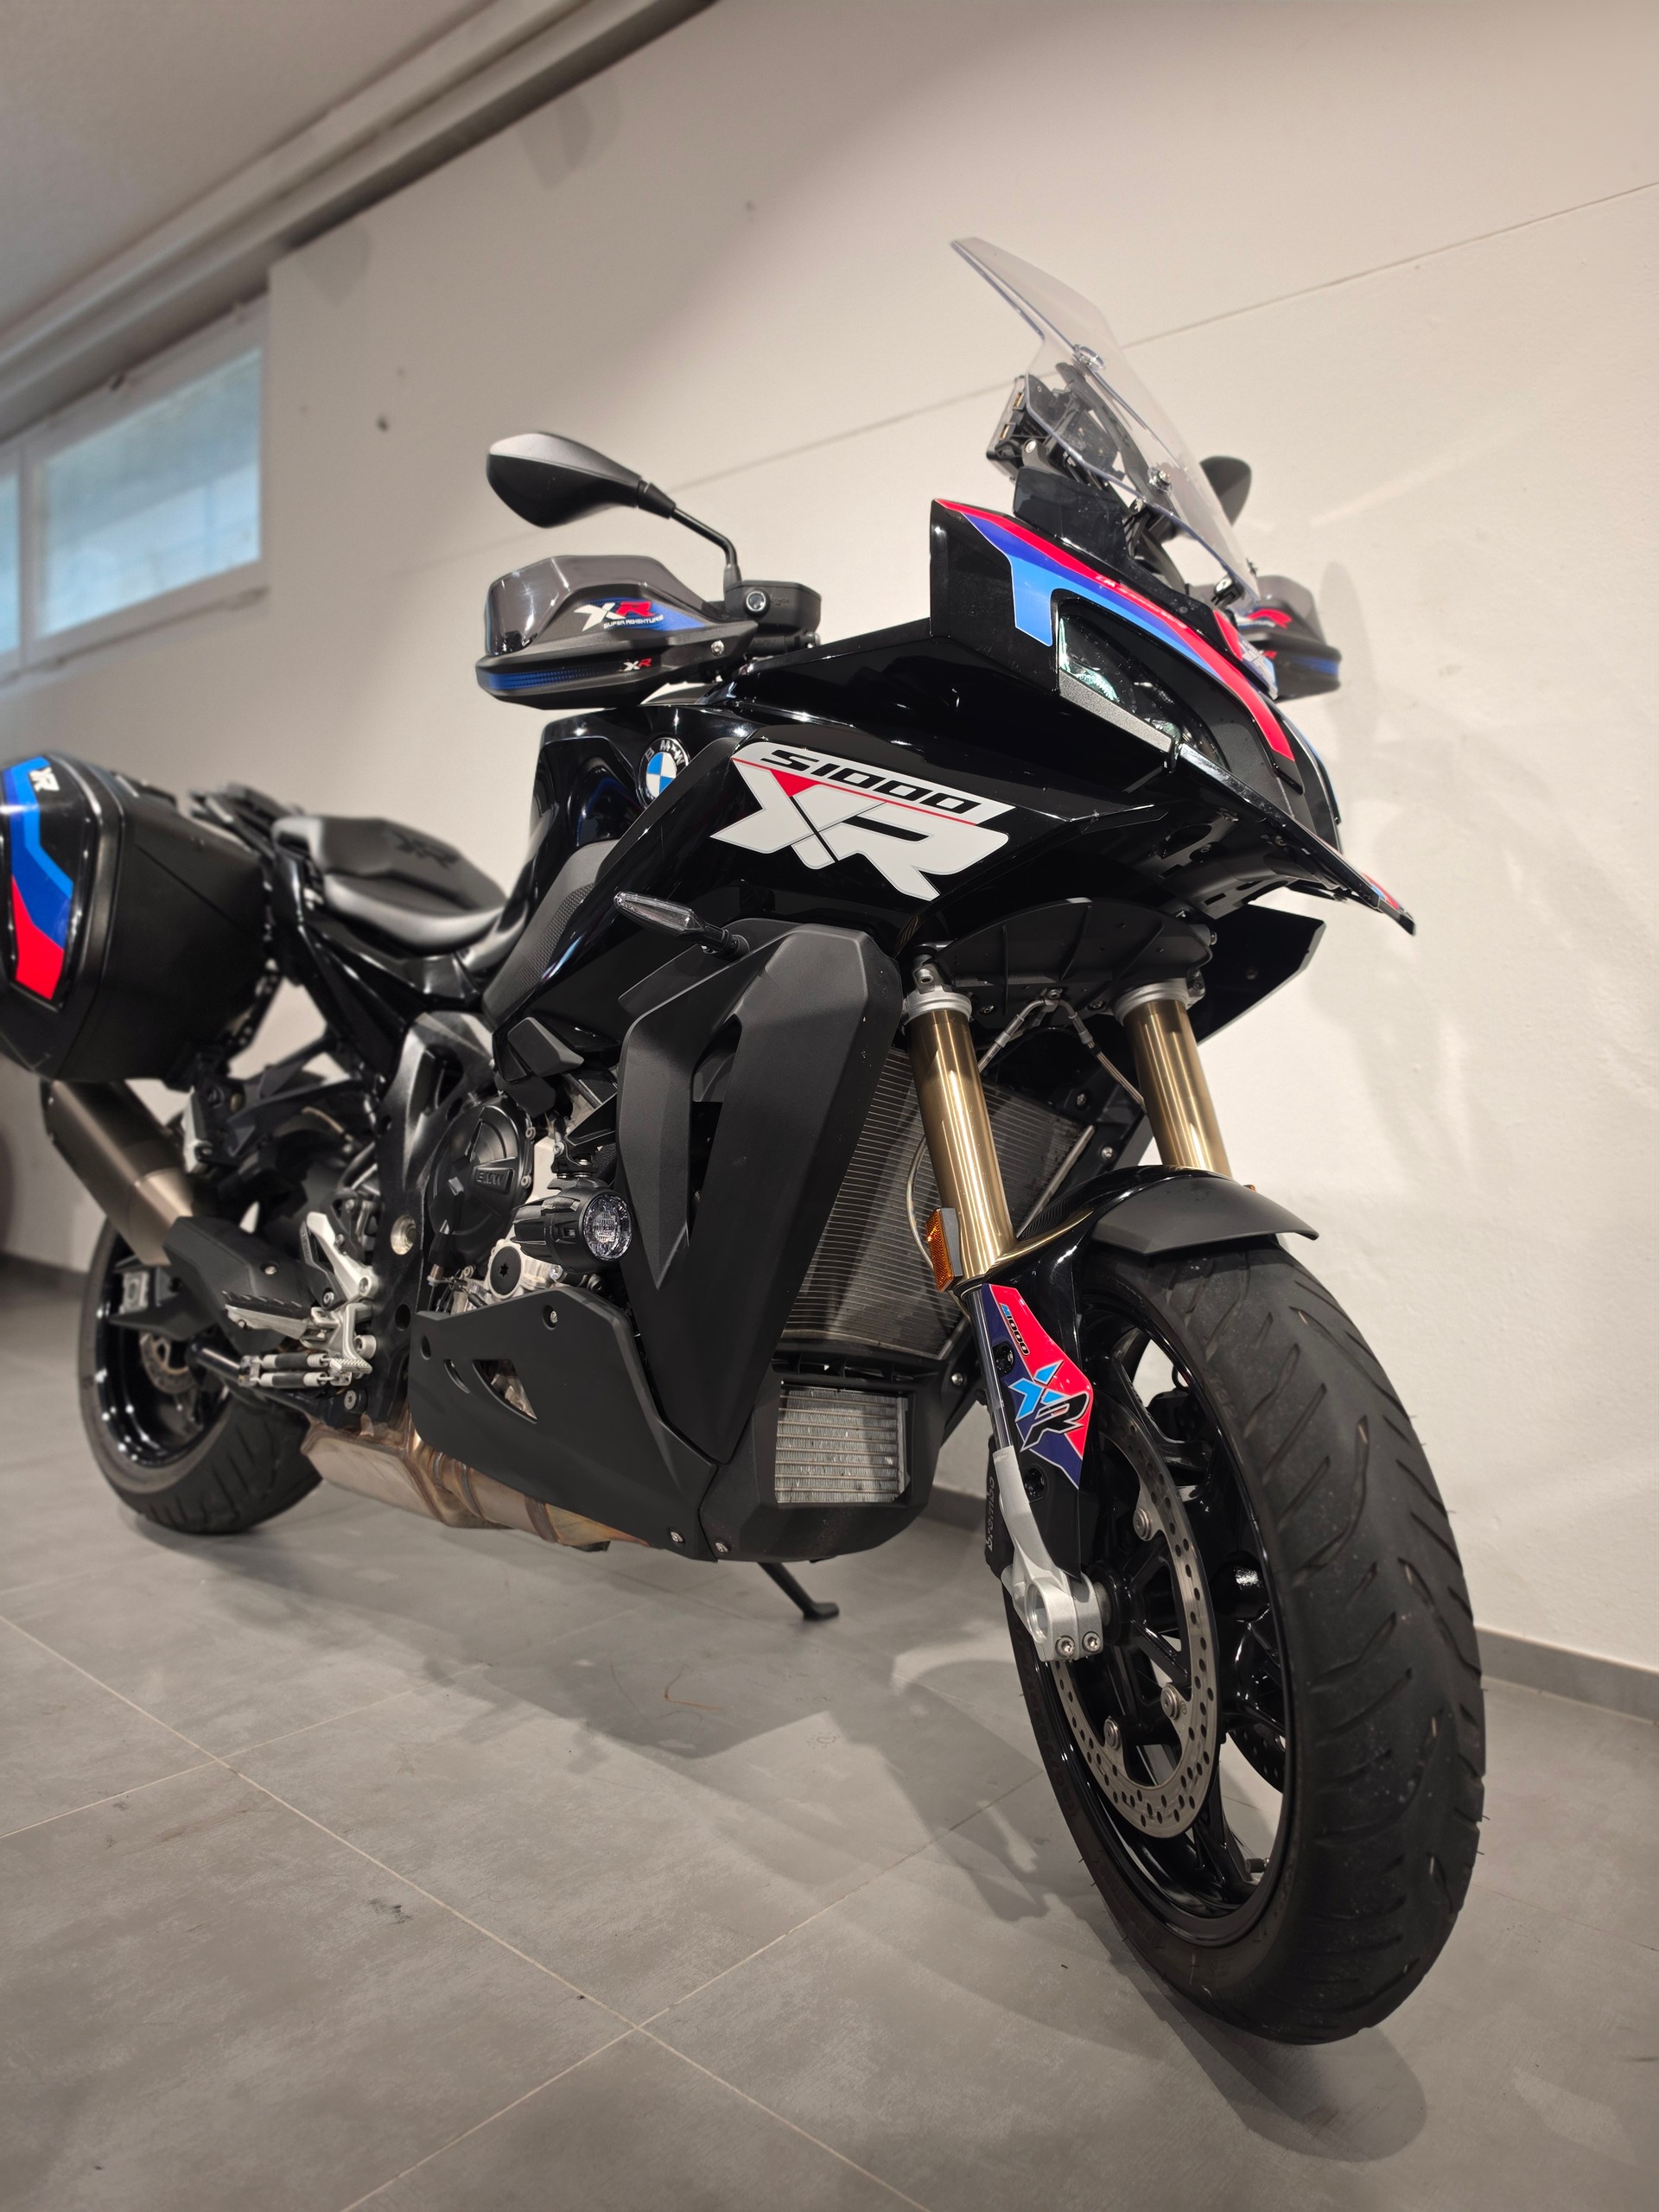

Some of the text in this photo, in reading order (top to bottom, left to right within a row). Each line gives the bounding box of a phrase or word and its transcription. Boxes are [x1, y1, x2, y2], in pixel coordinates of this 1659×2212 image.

[574, 601, 656, 632] XR
[622, 658, 652, 671] XR
[645, 739, 685, 766] BMW
[760, 749, 982, 814] S1000
[709, 758, 1009, 901] XR
[1008, 1359, 1089, 1452] XR
